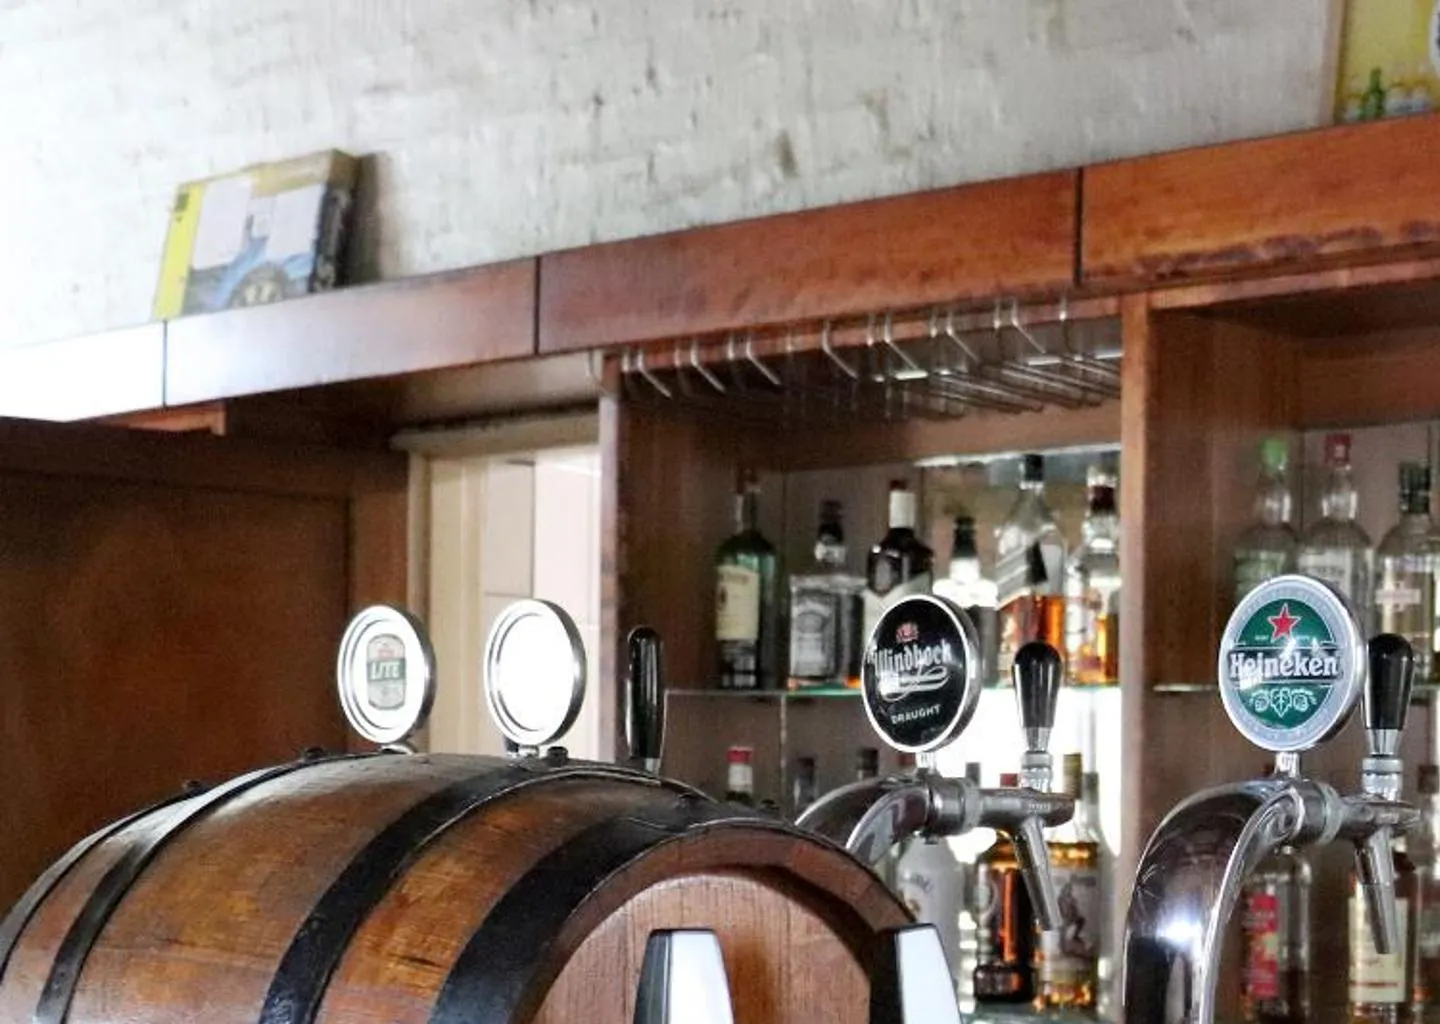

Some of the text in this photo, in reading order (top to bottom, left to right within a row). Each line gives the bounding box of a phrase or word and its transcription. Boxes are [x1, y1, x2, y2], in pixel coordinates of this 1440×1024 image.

[371, 660, 401, 680] LITE
[1229, 650, 1339, 679] Heineken
[890, 703, 941, 725] DRAUGHT
